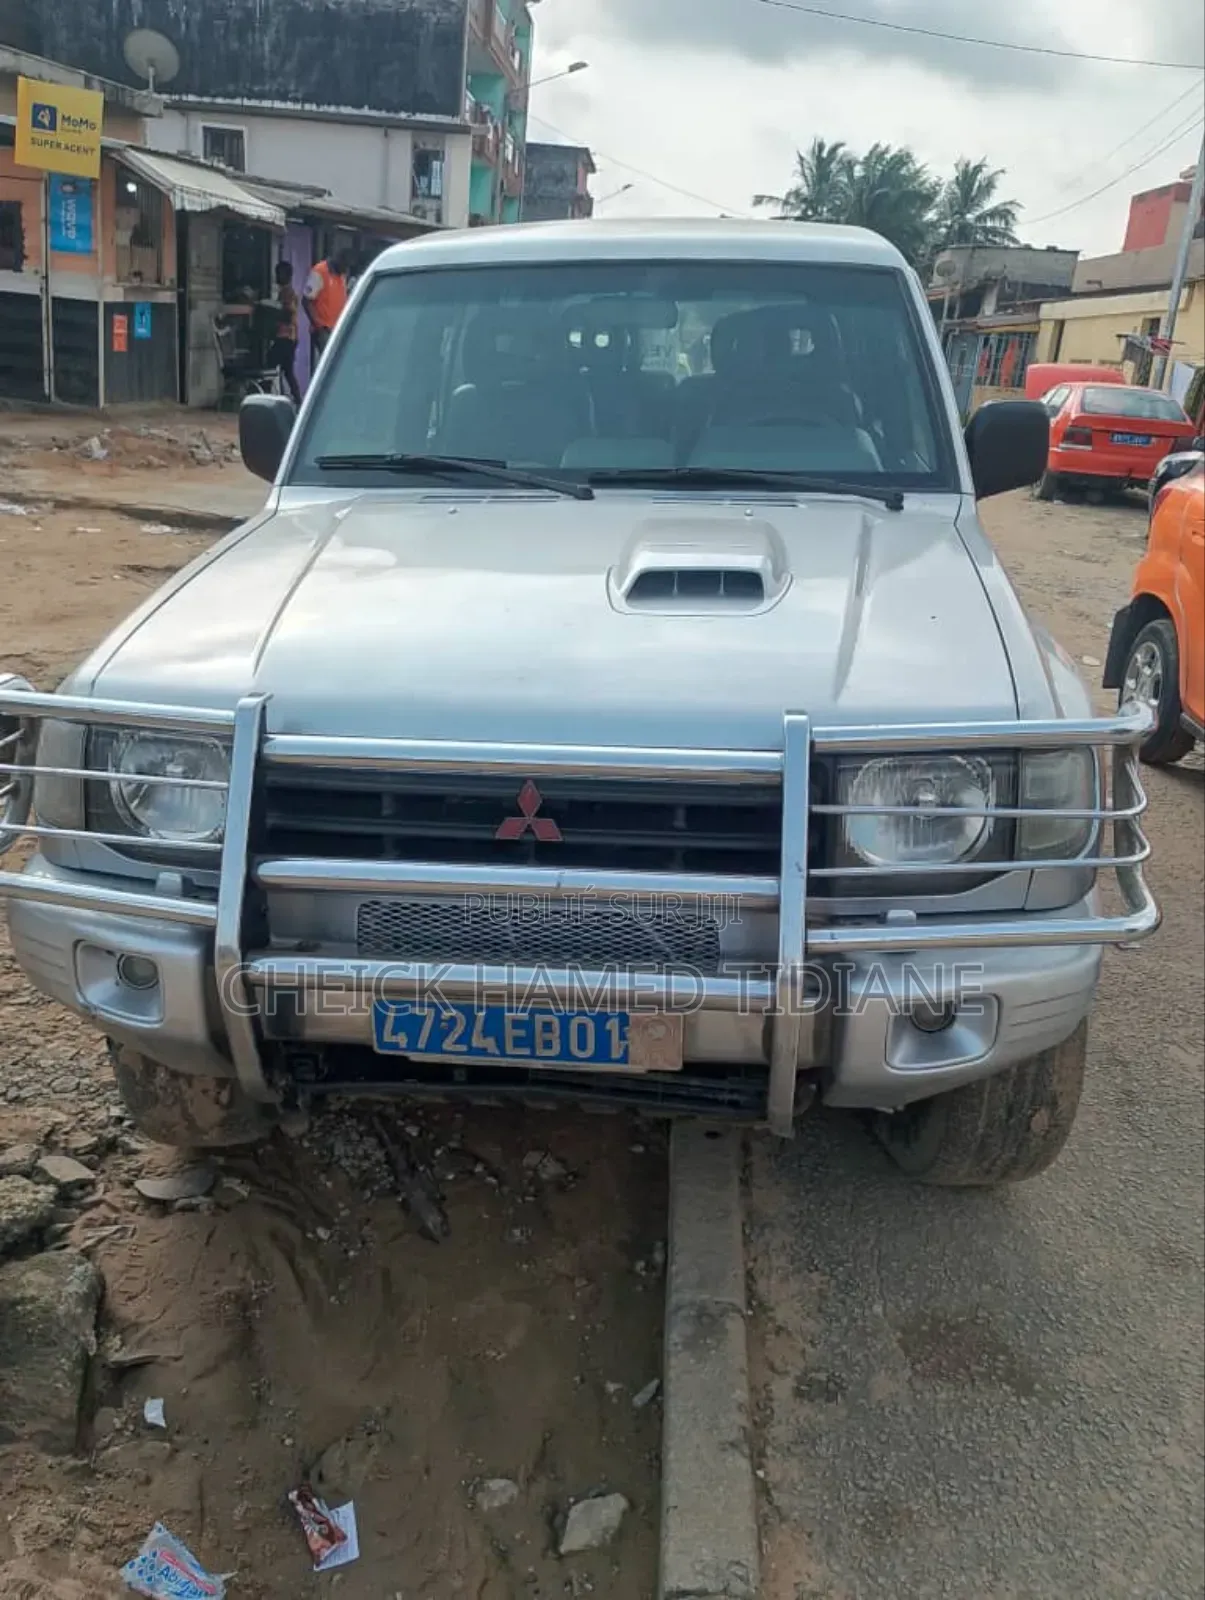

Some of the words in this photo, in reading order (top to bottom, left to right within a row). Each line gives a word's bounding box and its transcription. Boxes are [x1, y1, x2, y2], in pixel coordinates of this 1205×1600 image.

[61, 114, 97, 131] MoMo
[31, 137, 62, 151] SUPER
[63, 143, 96, 157] AGENT
